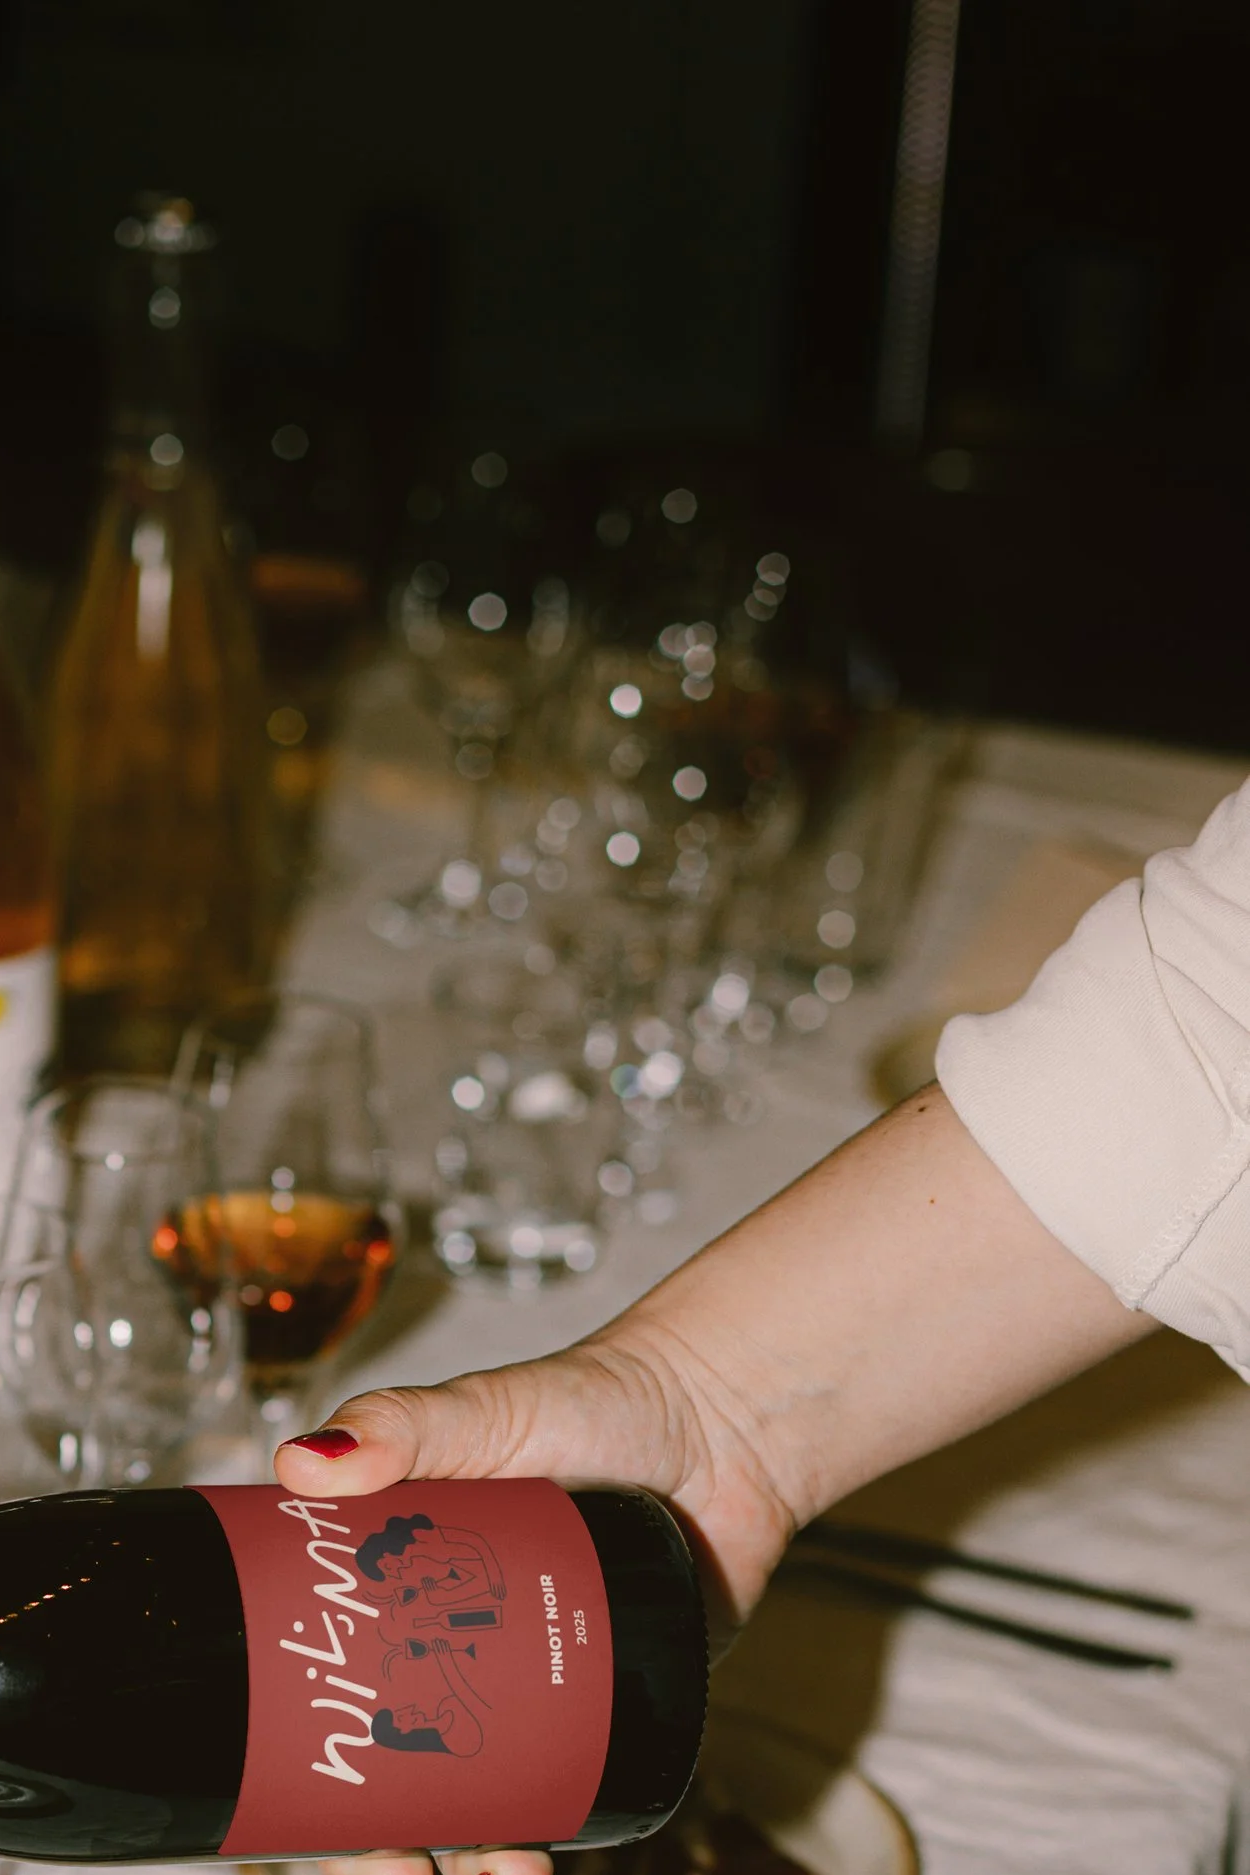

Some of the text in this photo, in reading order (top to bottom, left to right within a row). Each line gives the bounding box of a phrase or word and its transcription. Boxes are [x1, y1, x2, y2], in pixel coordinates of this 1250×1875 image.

[540, 1575, 564, 1684] PINOT NOIR
[574, 1611, 587, 1645] 2025
